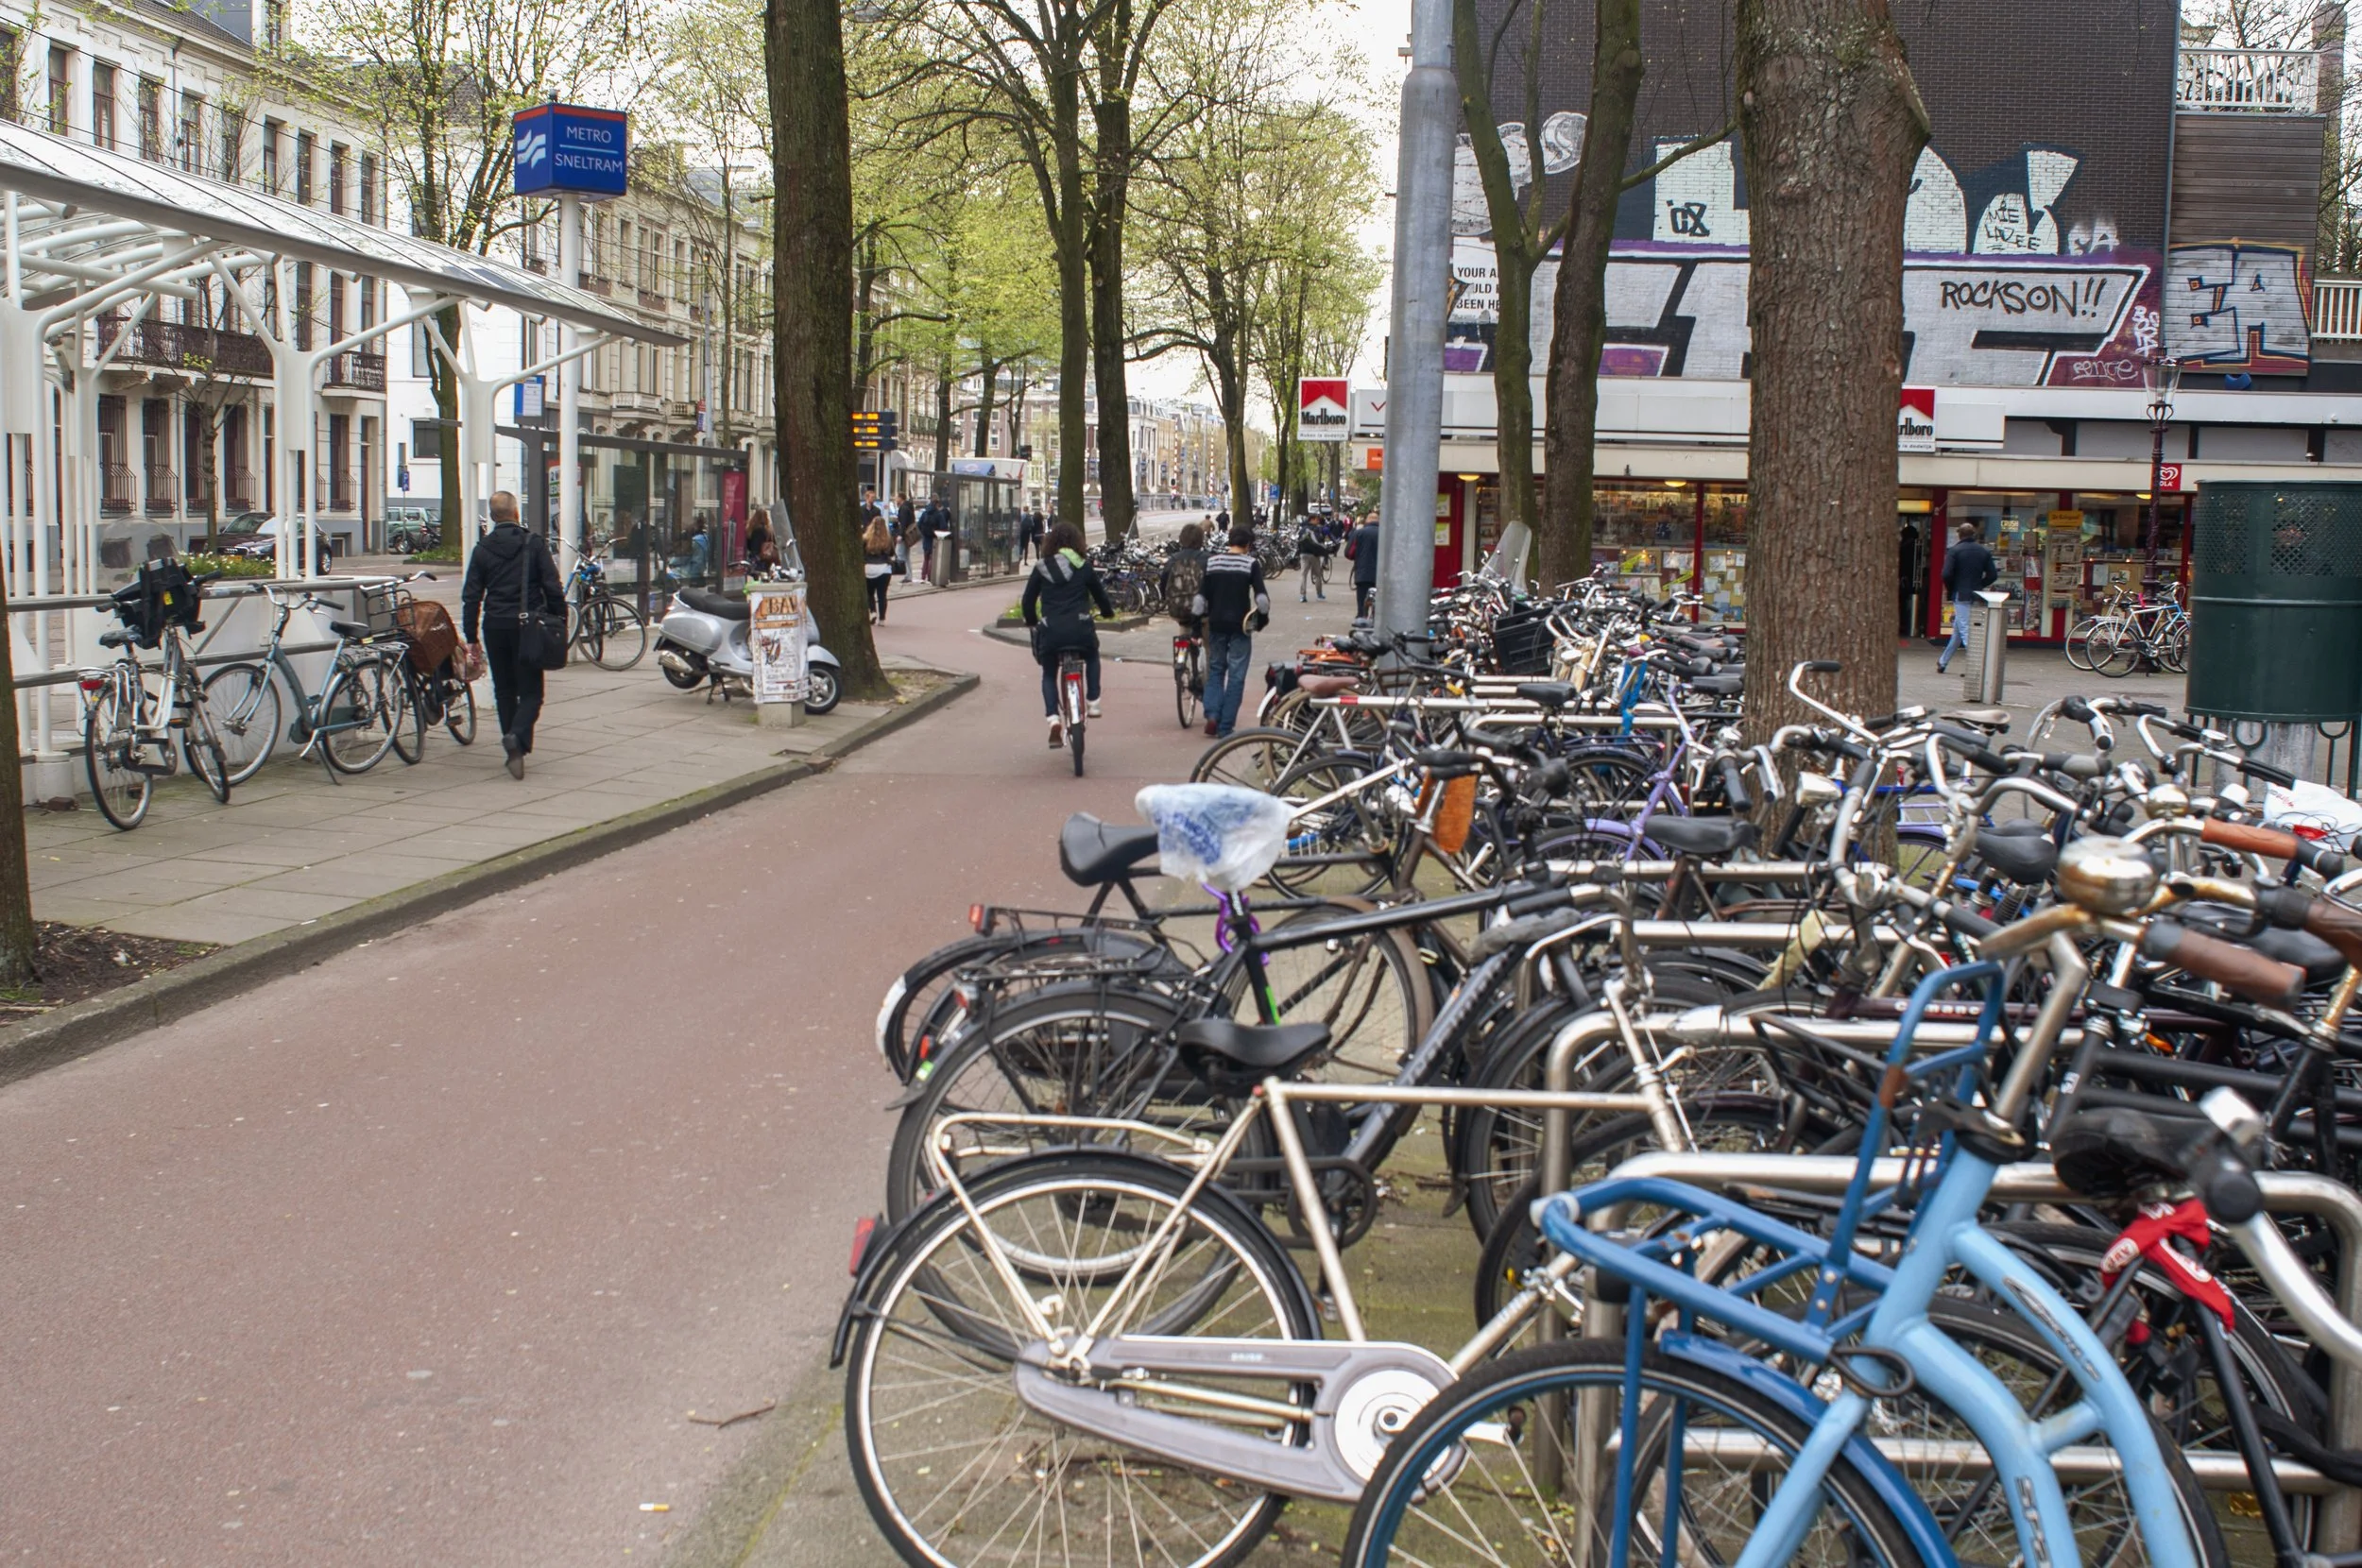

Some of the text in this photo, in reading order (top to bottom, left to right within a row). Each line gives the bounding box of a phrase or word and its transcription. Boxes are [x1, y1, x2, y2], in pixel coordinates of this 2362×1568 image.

[566, 126, 612, 144] METRO
[555, 153, 623, 174] SNELTRAM
[1457, 267, 1499, 278] YOUR A
[1488, 299, 1500, 310] HE
[1301, 408, 1345, 424] Marlboro
[1898, 417, 1933, 435] rlboro
[1894, 1001, 1980, 1014] Cmanc
